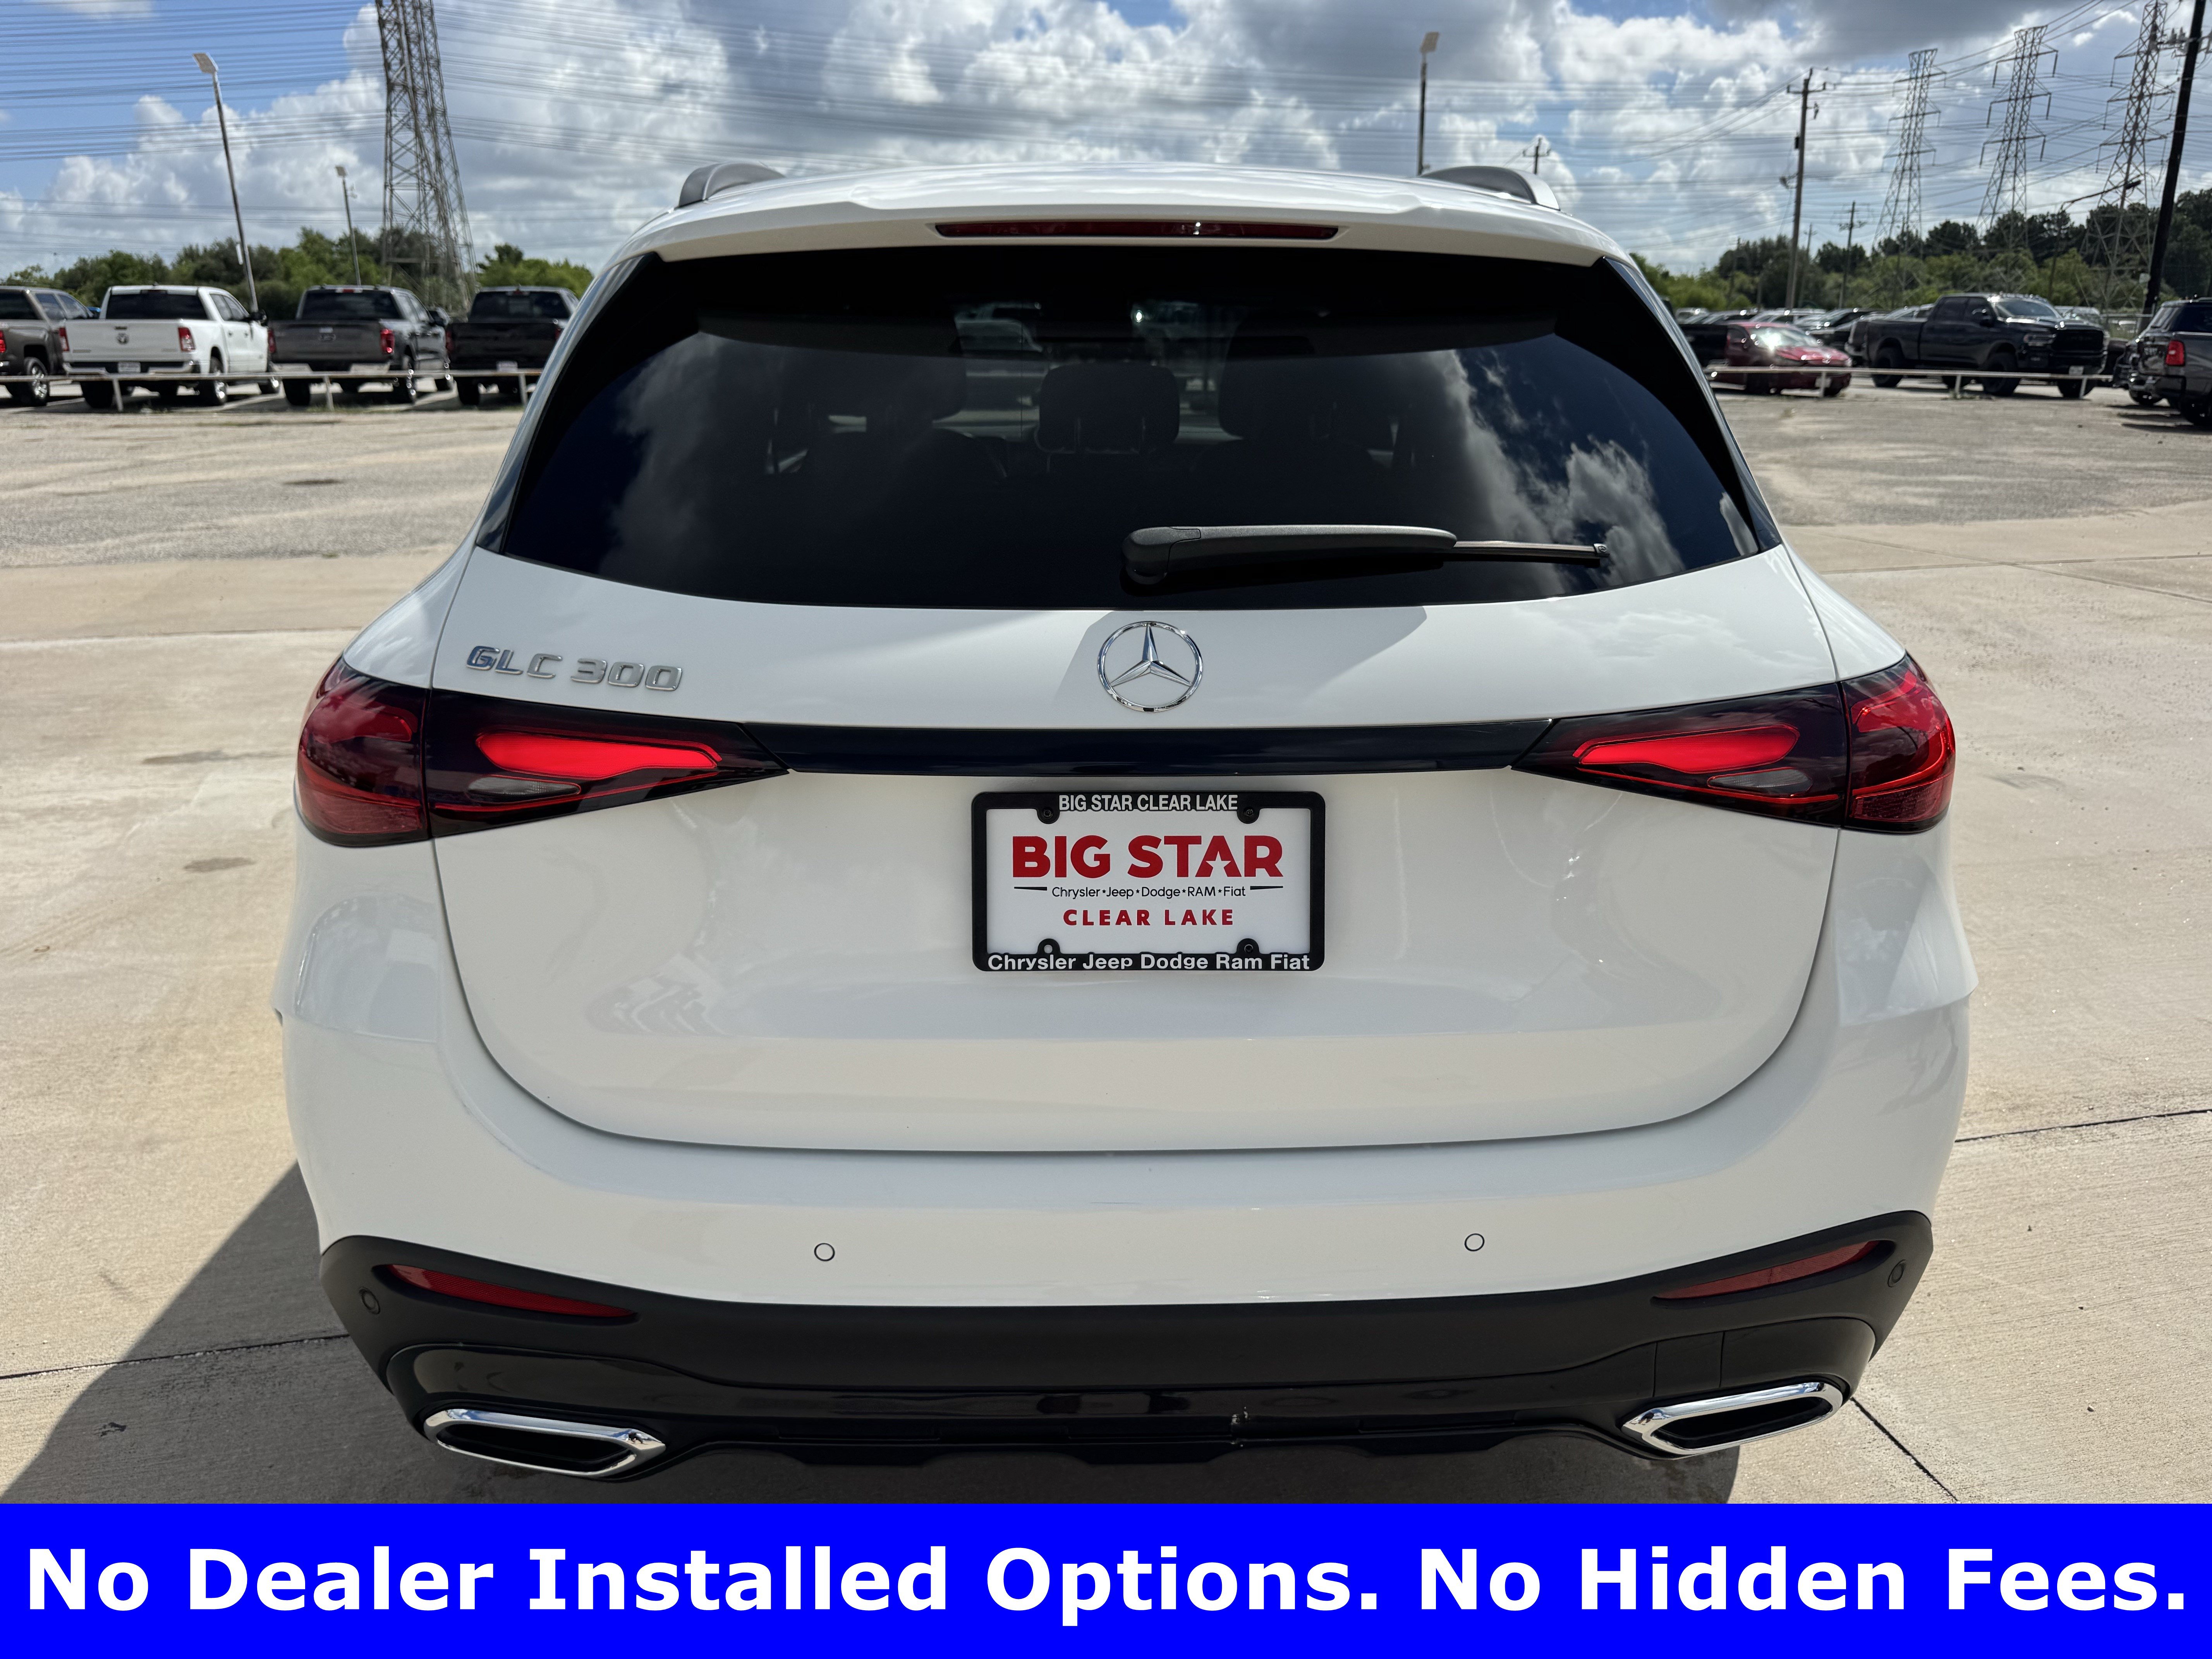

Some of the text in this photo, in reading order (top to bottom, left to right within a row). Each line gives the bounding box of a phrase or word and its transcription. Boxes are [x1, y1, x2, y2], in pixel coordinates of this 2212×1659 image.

[466, 645, 682, 692] GLC 300
[1059, 794, 1238, 811] BIG STAR CLEAR LAKE
[1013, 835, 1283, 878] BIG STAR
[1052, 886, 1246, 900] Chrysler Jeep Dodge RAM Fiat
[1063, 909, 1233, 926] CLEAR LAKE
[988, 954, 1310, 970] Chrysler Jeep Dodge Ram Fiat
